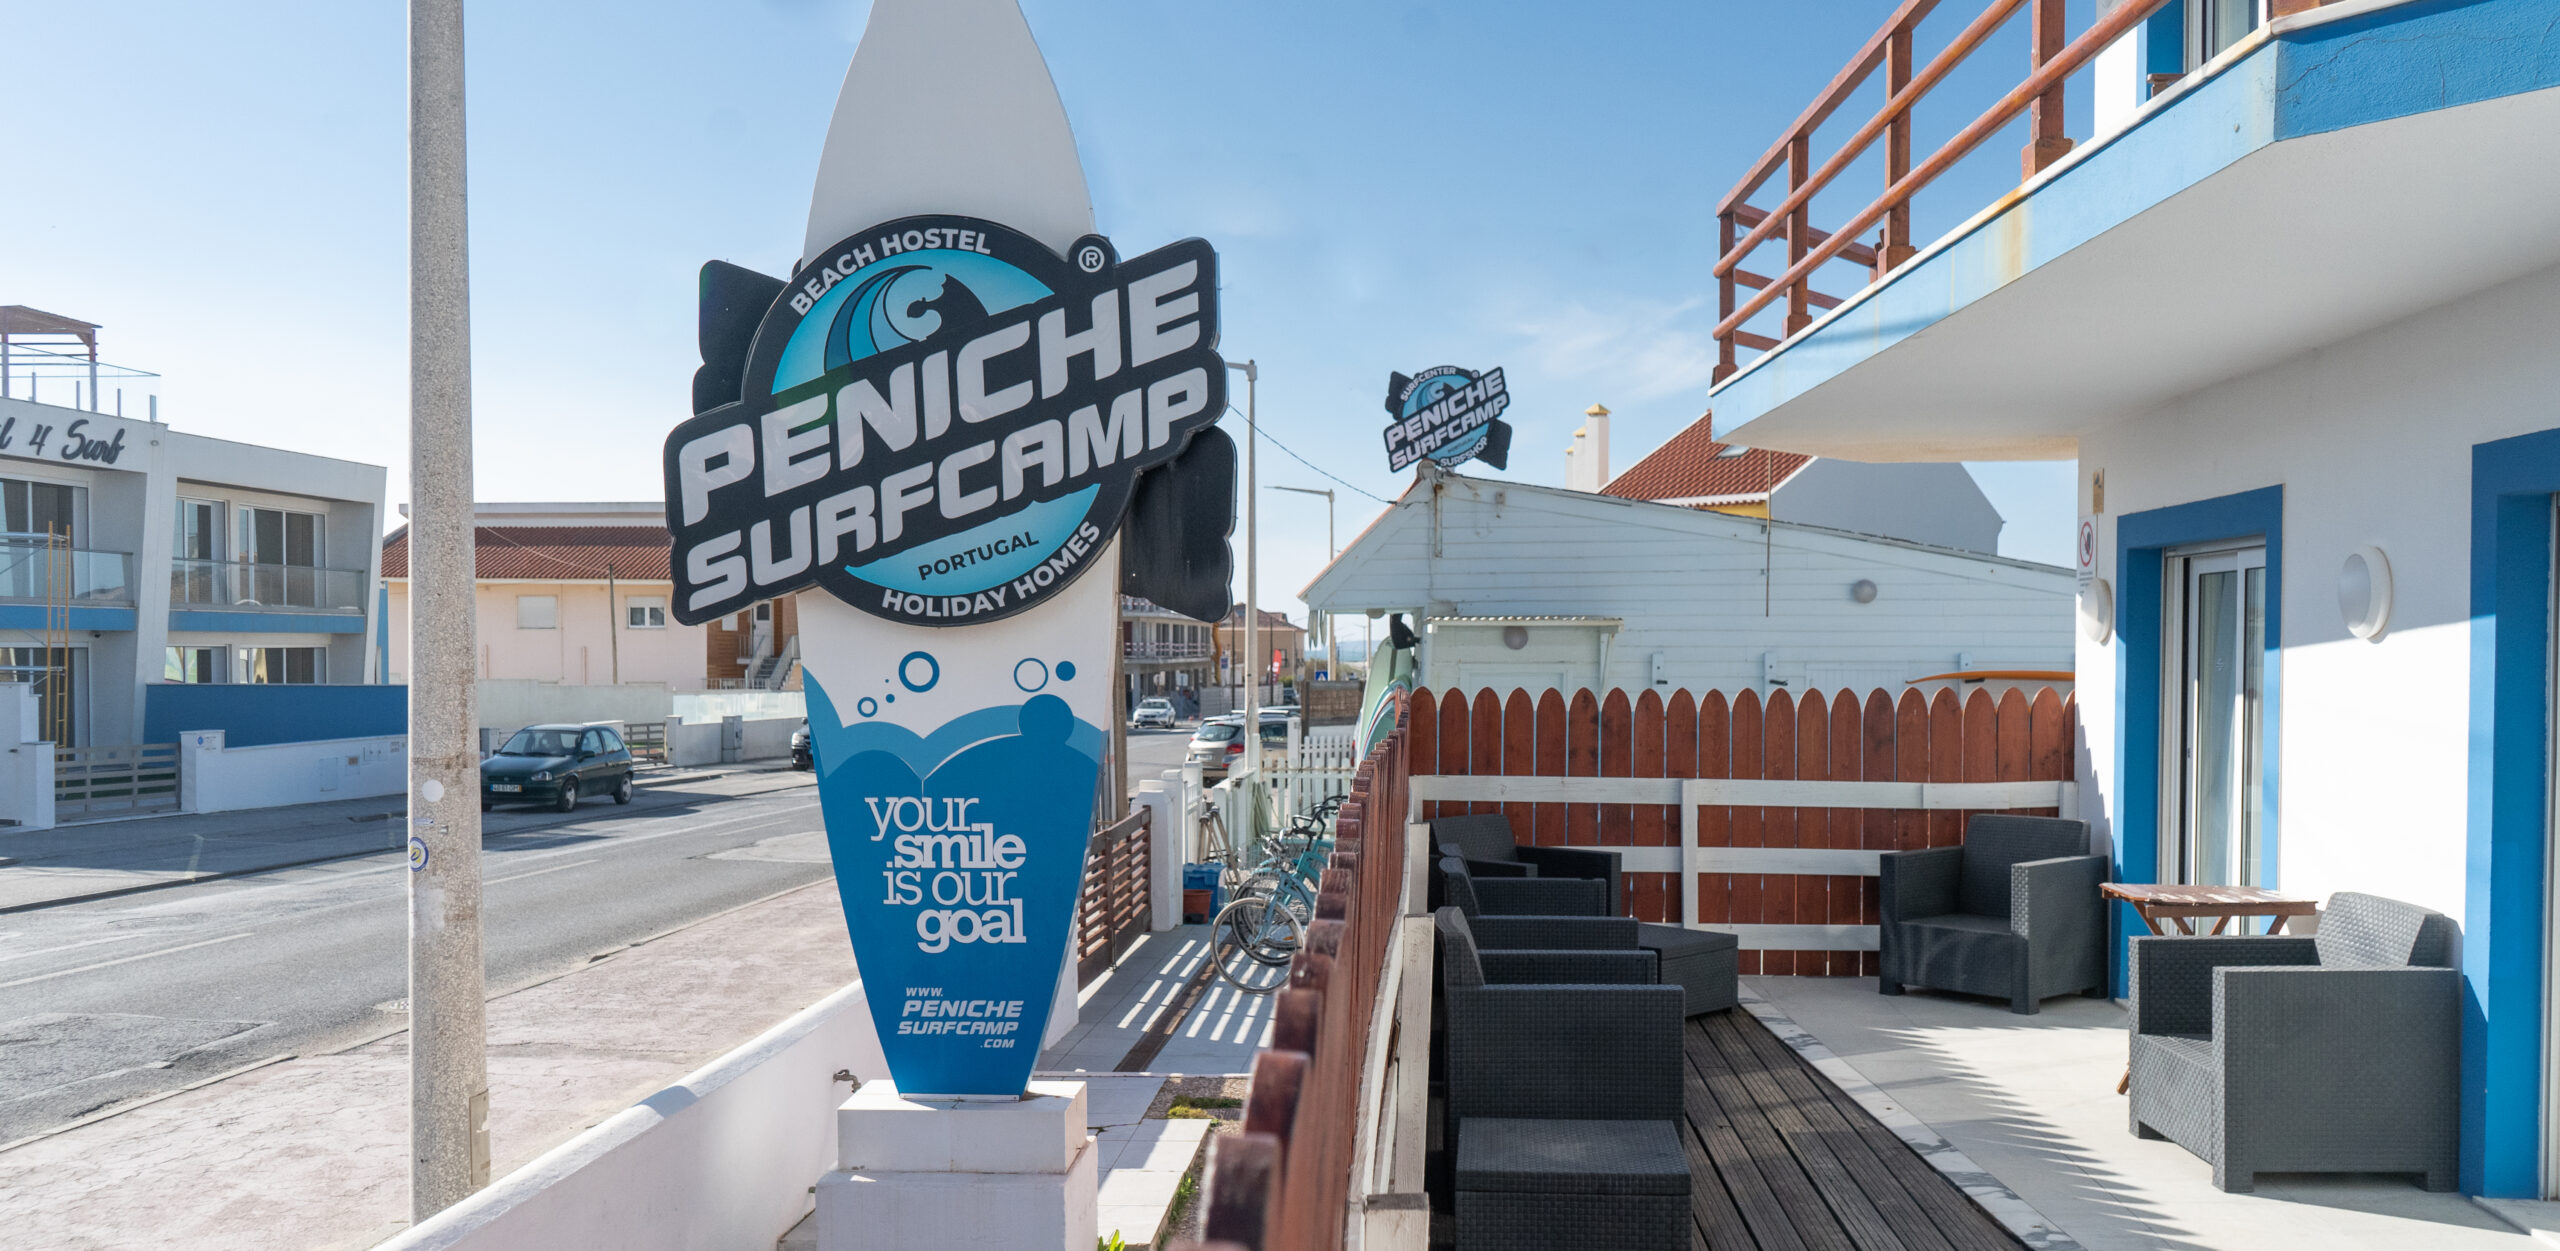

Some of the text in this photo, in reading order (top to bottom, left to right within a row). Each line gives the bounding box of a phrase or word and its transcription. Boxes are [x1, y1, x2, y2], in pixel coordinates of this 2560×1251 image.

[789, 227, 992, 317] BEACH HOSTEL
[679, 259, 1200, 527] PENICHE
[1400, 367, 1457, 401] SURFCENTER
[1386, 369, 1503, 452] PENICHE
[1391, 393, 1507, 471] SURFCAMP
[29, 423, 53, 456] 4
[61, 419, 126, 465] Surf
[1440, 436, 1488, 467] SURFSHOP
[686, 367, 1208, 612] SURFCAMP
[882, 520, 1102, 618] HOLIDAY HOMES
[918, 531, 1040, 581] PORTUGAL
[864, 796, 980, 842] your
[894, 823, 1027, 869] smile
[883, 861, 1018, 905] is our
[916, 898, 1027, 953] goal
[897, 1021, 1019, 1035] SURFCAMP
[902, 1000, 1025, 1018] PENICHE
[980, 1038, 1015, 1049] .COM
